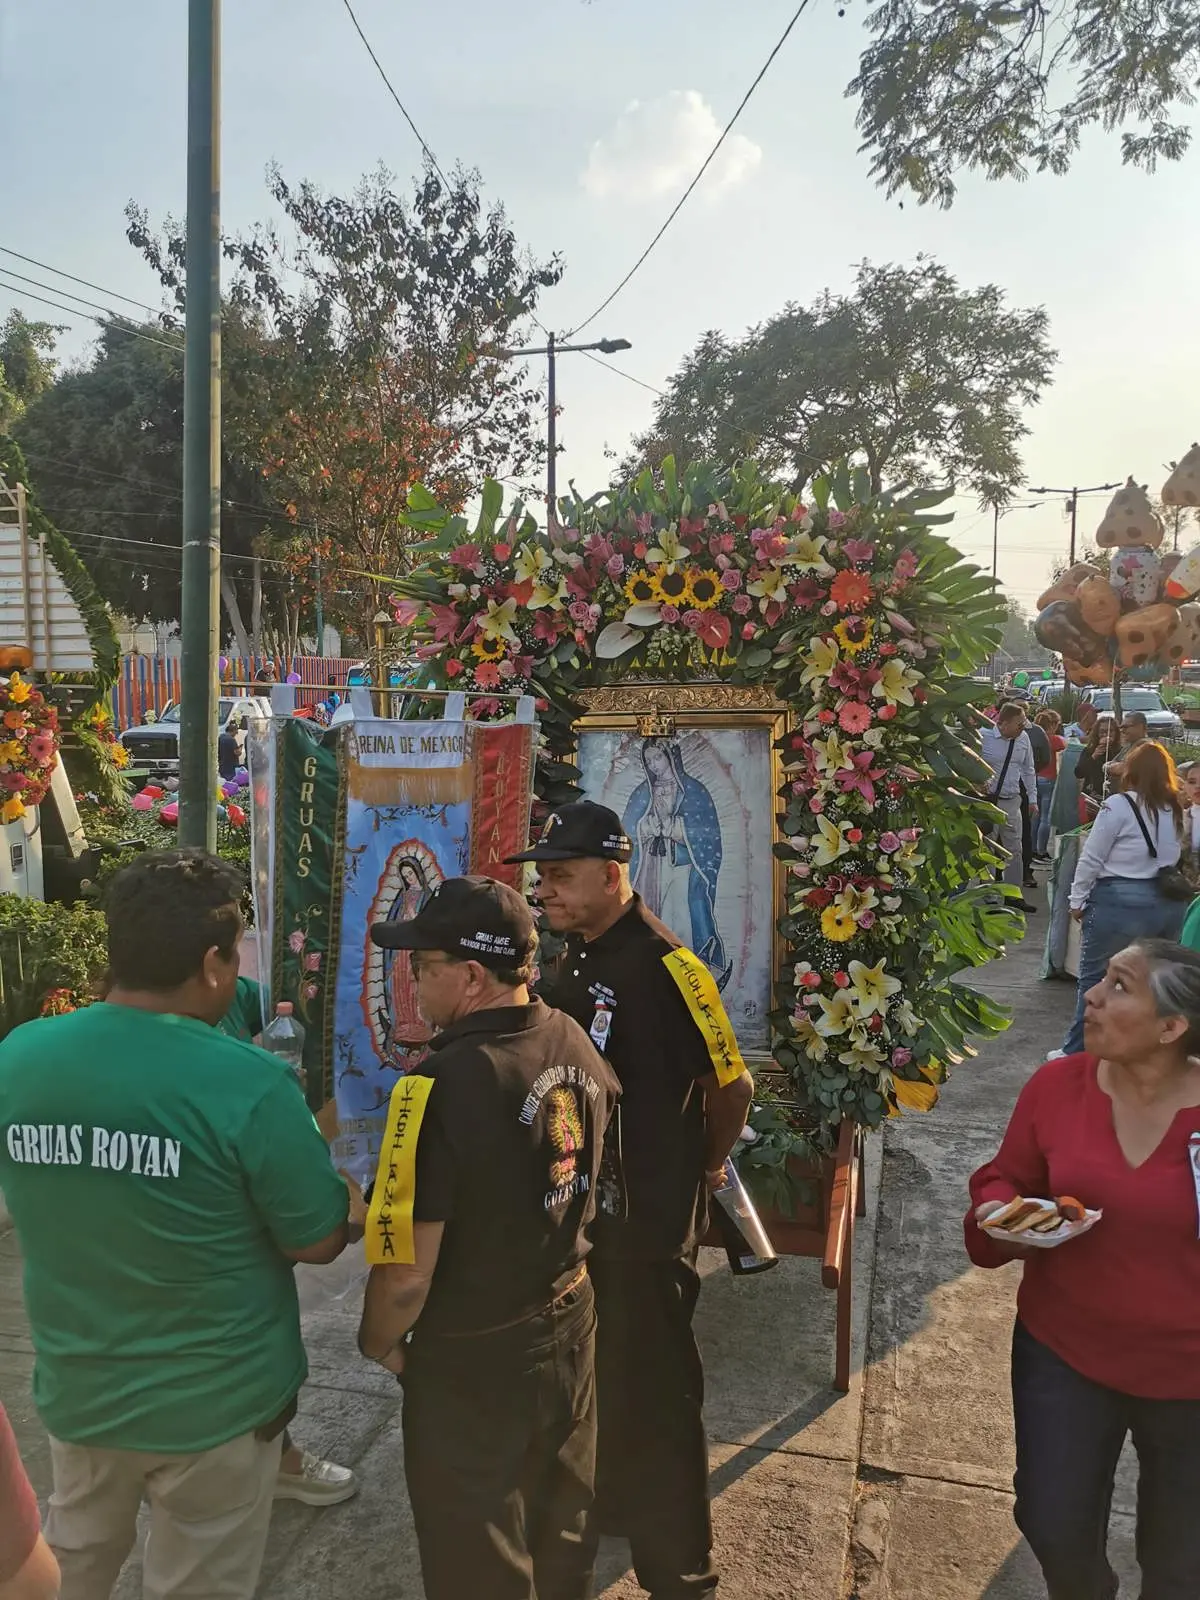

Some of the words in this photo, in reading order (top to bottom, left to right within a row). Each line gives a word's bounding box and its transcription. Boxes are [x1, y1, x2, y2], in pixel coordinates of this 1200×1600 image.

[359, 735, 396, 755] REINA
[400, 735, 416, 755] DE
[420, 735, 464, 754] MEXICO
[296, 756, 318, 878] GRUAS
[518, 1091, 541, 1125] COMITE
[6, 1123, 83, 1165] GRUAS
[90, 1126, 182, 1178] ROYAN
[377, 1079, 417, 1257] VIGILANCIA
